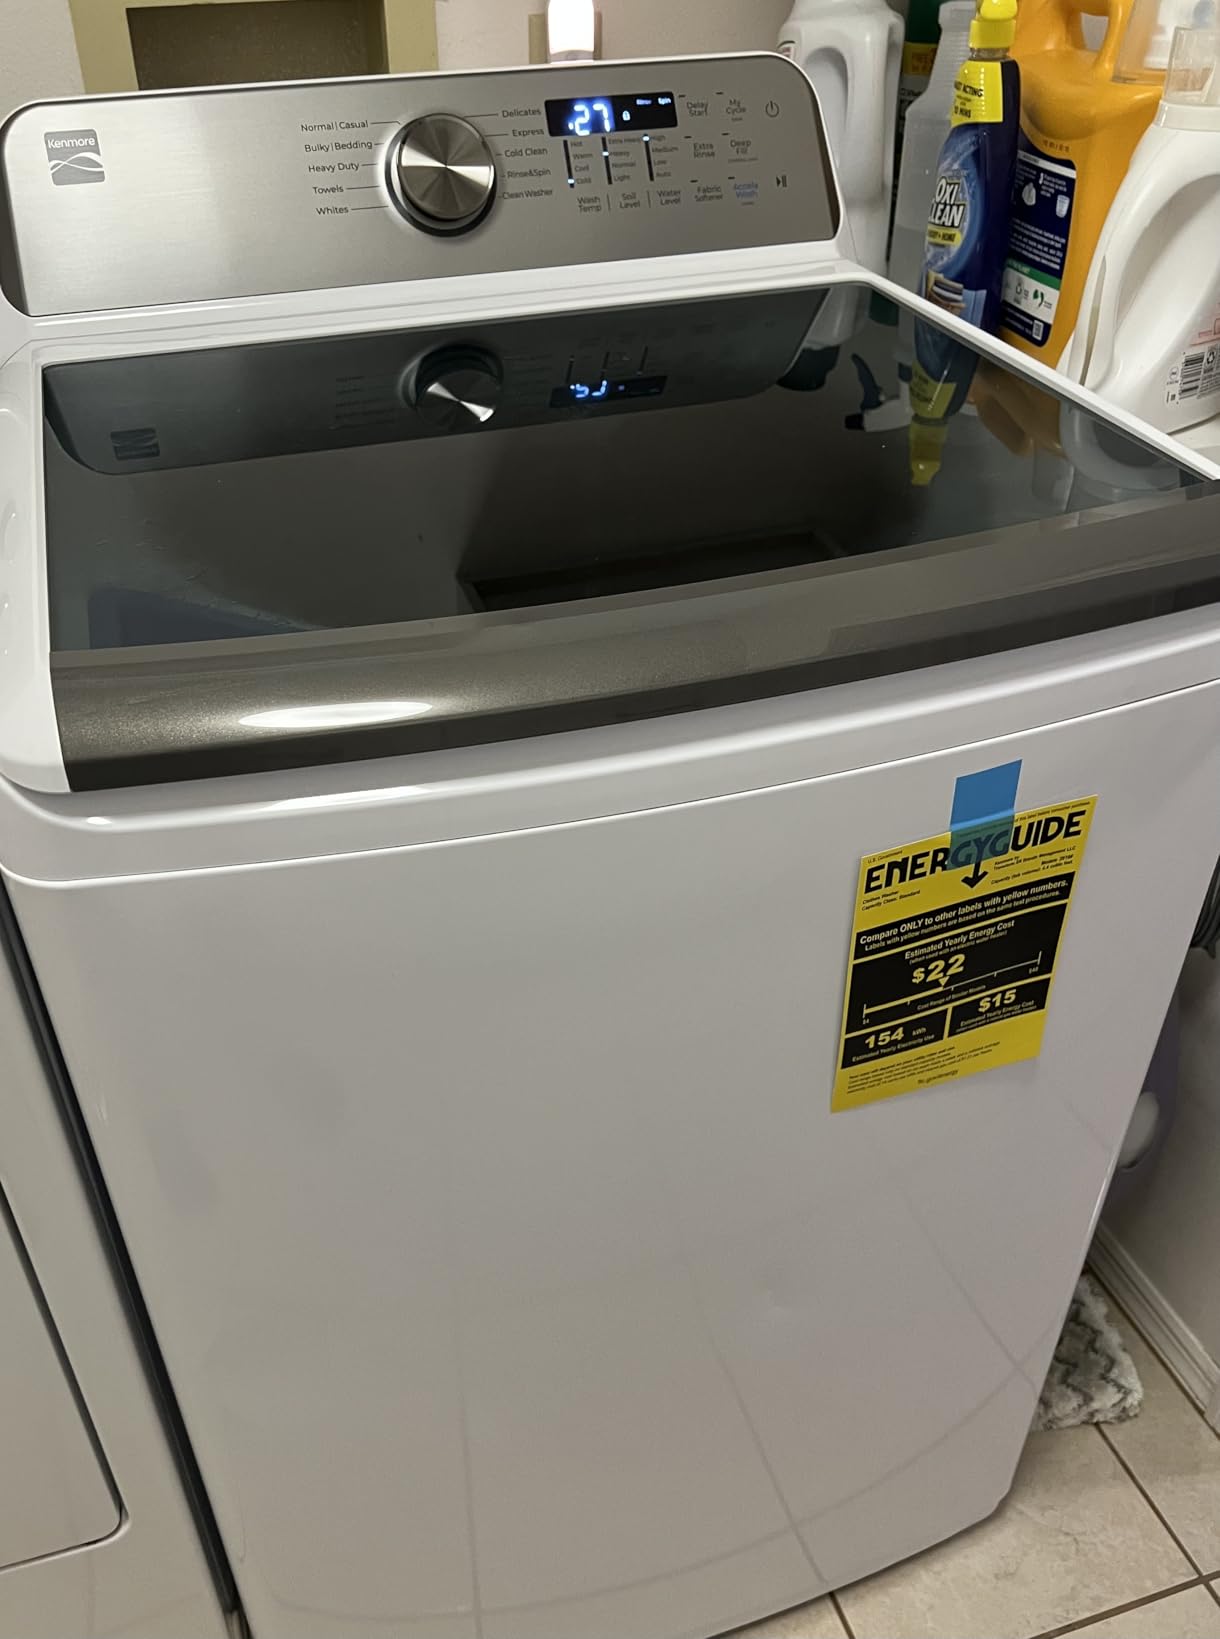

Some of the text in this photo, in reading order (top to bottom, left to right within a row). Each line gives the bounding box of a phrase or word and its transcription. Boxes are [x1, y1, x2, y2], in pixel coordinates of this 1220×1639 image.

[963, 83, 984, 98] ACTING
[502, 108, 542, 118] Delicates
[512, 128, 544, 138] Express
[47, 137, 96, 149] Kenmore
[694, 142, 714, 151] Extra
[730, 140, 752, 148] Deep
[504, 147, 548, 158] Cold Clean
[308, 162, 360, 173] Heavy Duty
[312, 184, 344, 194] Towels
[656, 190, 682, 198] Water
[697, 185, 722, 194] Fabric
[936, 178, 959, 205] OXI
[576, 196, 600, 204] Wash
[621, 192, 637, 200] Soil
[660, 197, 681, 206] Level
[578, 204, 602, 213] Temp
[619, 200, 641, 209] Level
[316, 206, 349, 215] Whites
[930, 203, 964, 227] LEAN
[864, 810, 1086, 894] ENERGYGUIDE
[860, 880, 1068, 944] Compare ONLY to other labels with yellow numbers.
[864, 942, 886, 952] Labels
[886, 936, 900, 945] with
[900, 931, 920, 942] yellow
[920, 923, 946, 935] numbers
[958, 912, 976, 923] based
[996, 902, 1012, 911] same
[1014, 899, 1025, 907] test
[904, 920, 1015, 960] Estimated Yearly Energy Cost
[912, 954, 966, 984] $22
[978, 988, 1017, 1013] $15
[864, 1026, 926, 1048] 154 kWh
[852, 1049, 880, 1062] Estimated
[880, 1045, 896, 1054] Yearly
